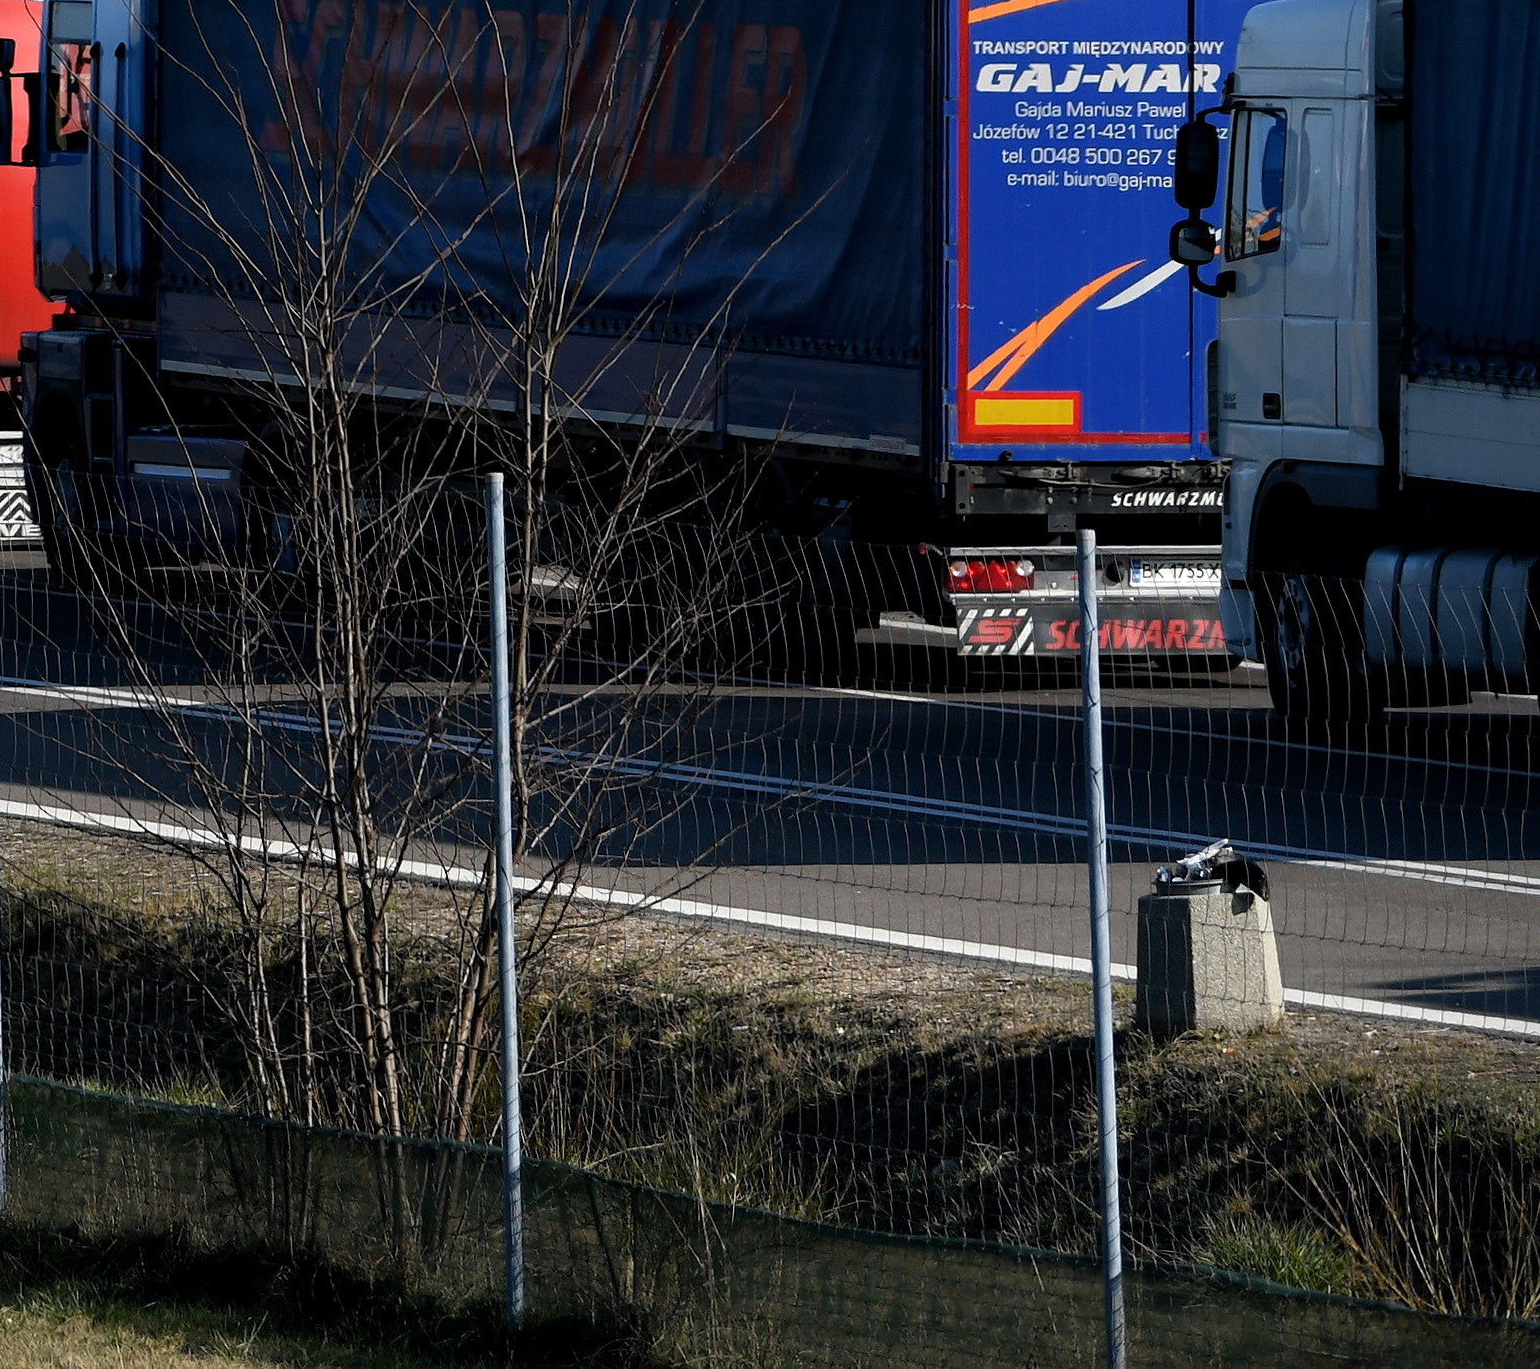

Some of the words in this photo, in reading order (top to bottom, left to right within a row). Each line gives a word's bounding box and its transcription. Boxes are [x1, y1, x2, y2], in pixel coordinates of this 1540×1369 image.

[973, 41, 1070, 55] TRANSPORT
[1073, 41, 1224, 58] MIĘDZYNARODOWY
[976, 63, 1221, 93] GAJ-MAR
[1015, 101, 1062, 120] Gajda
[1067, 101, 1132, 118] Mariusz
[973, 123, 1040, 140] Józefów
[1046, 123, 1069, 140] 12
[1074, 123, 1137, 140] 21-421
[1002, 148, 1027, 164] tel.
[1031, 148, 1080, 165] 0048
[1085, 149, 1122, 165] 500
[1126, 149, 1162, 165] 267
[1007, 170, 1060, 187] e-mail:
[1063, 171, 1173, 191] biuro@gaj-ma
[1142, 563, 1165, 578] BK
[1171, 563, 1204, 578] 1755
